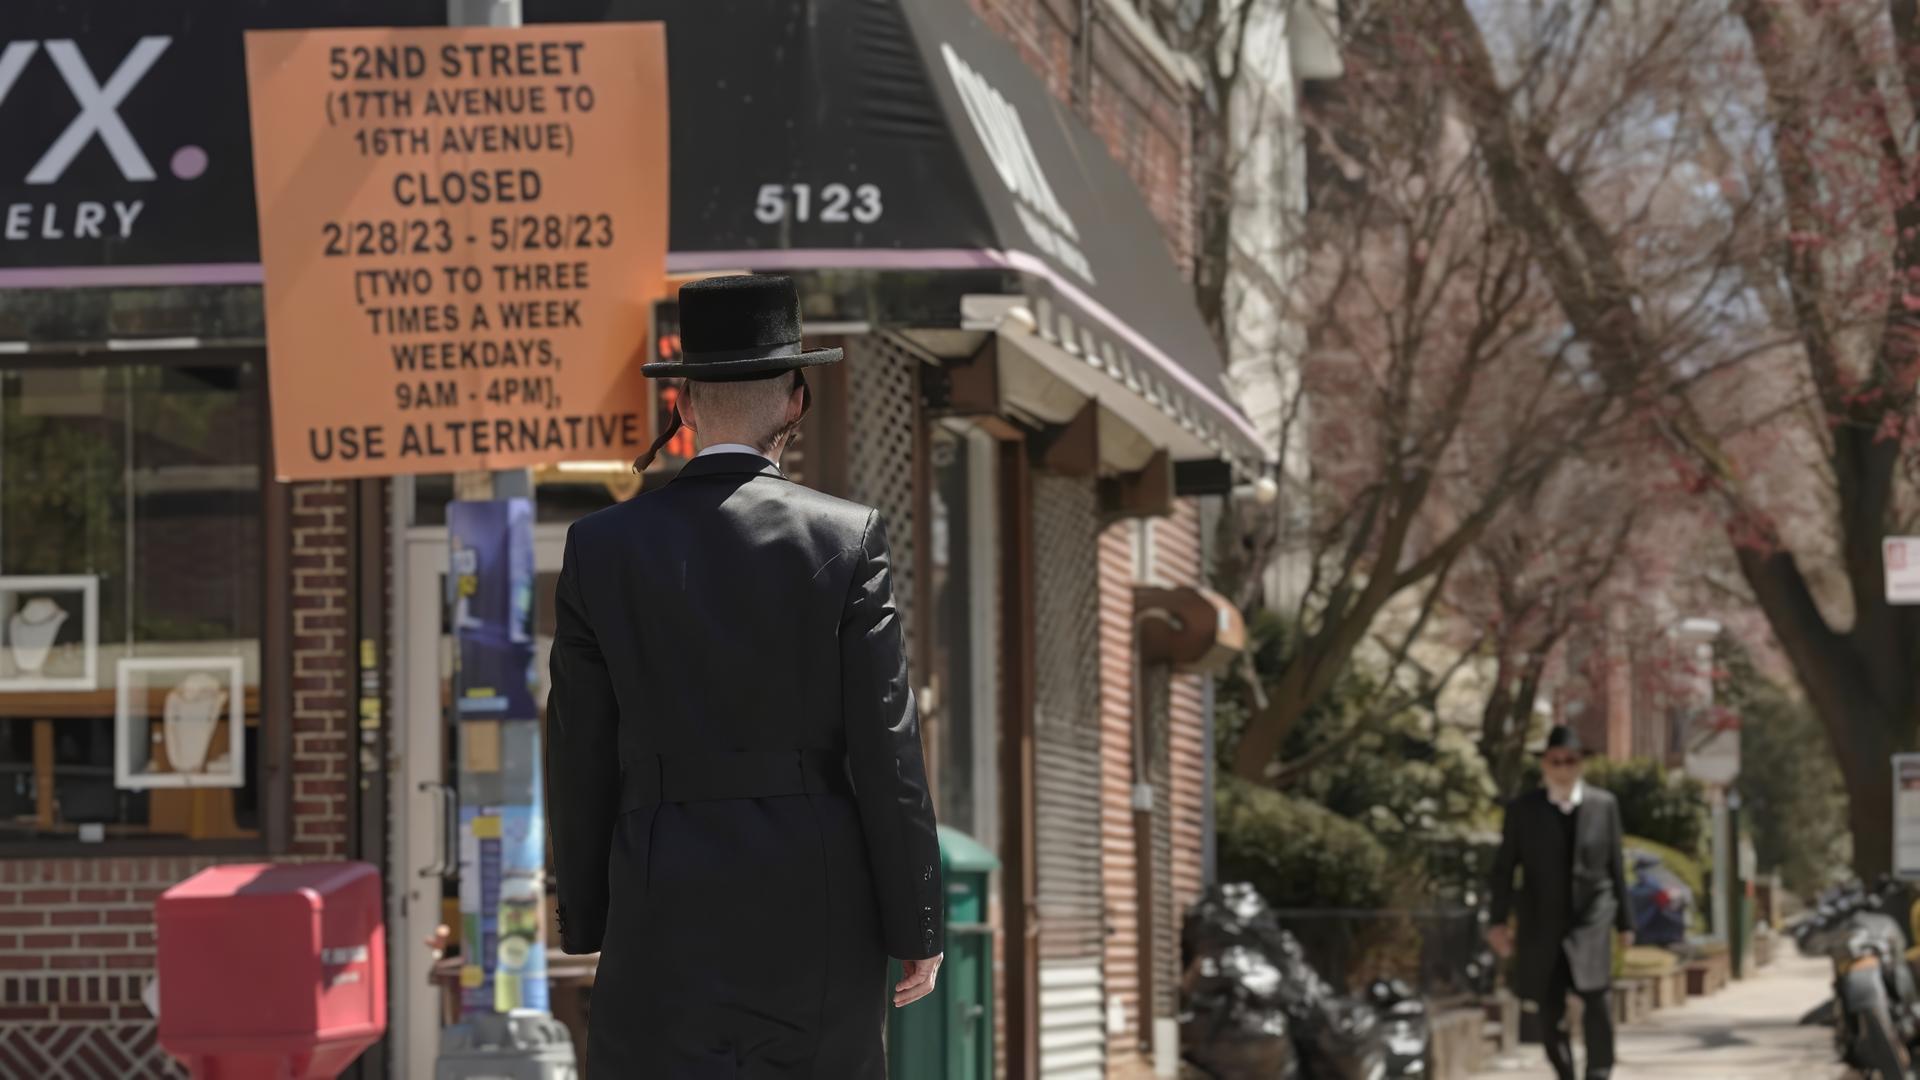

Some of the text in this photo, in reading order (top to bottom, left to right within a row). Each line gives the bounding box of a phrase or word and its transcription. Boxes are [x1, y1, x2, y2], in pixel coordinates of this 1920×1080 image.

[331, 42, 584, 80] 52ND STREET
[328, 85, 594, 124] (17TH AVENUE TO
[355, 123, 573, 156] 16TH AVENUE)
[394, 169, 541, 206] CLOSED
[754, 182, 883, 223] 5123
[322, 219, 453, 257] 2/28/23
[491, 214, 613, 251] 5/28/23
[355, 262, 588, 304] [TWO TO THREE
[366, 301, 580, 334] TIMES A WEEK
[392, 339, 560, 371] WEEKDAYS,
[396, 381, 457, 410] 9AM
[486, 377, 560, 409] 4PM],
[310, 426, 384, 462] USE
[399, 414, 640, 458] ALTERNATIVE
